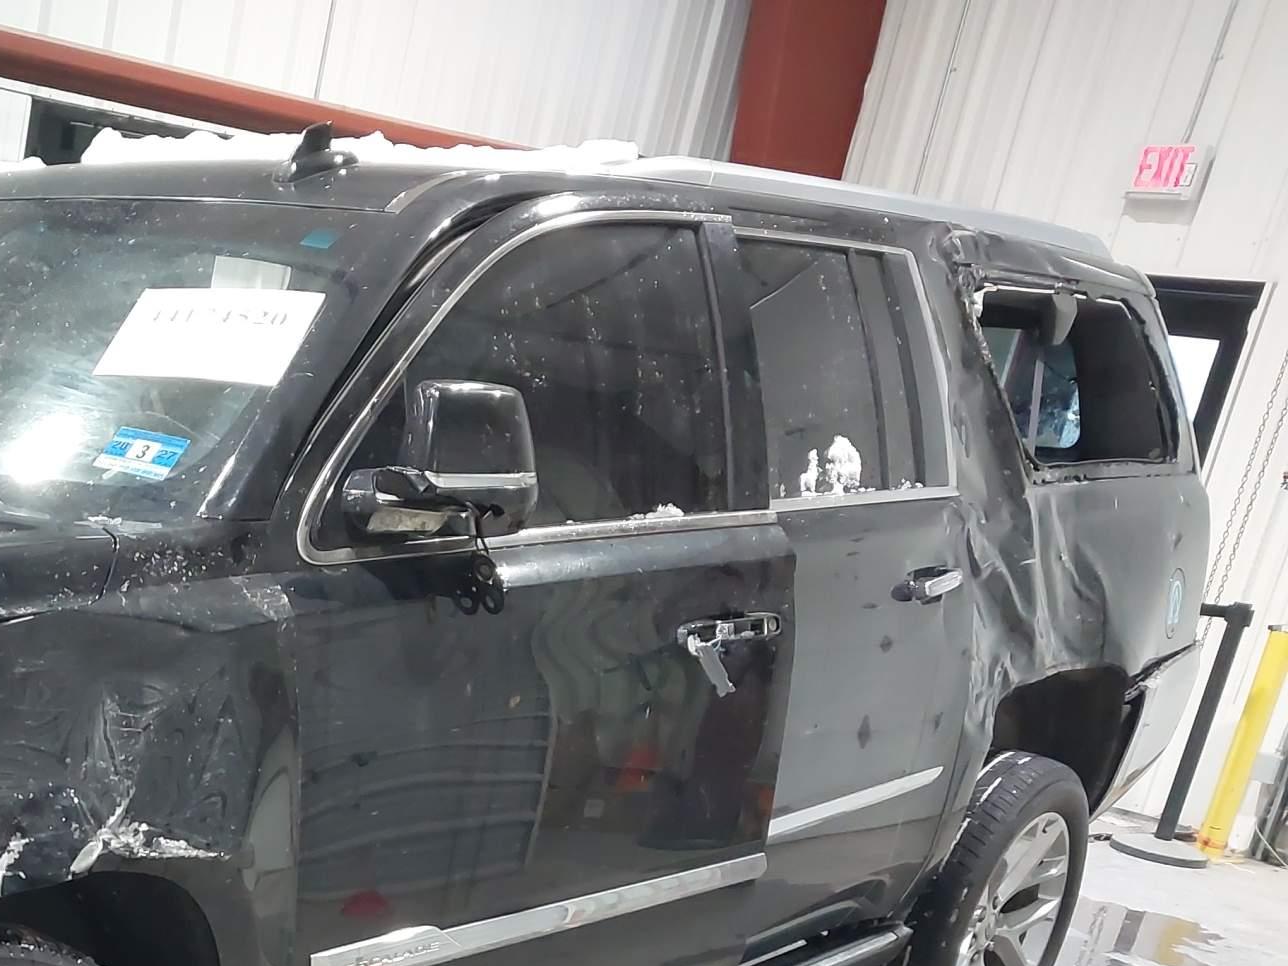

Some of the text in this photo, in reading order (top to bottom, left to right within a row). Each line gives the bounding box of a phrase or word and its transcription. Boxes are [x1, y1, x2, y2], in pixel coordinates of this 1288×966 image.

[1134, 146, 1195, 187] EXIT
[135, 444, 151, 459] 3
[157, 449, 178, 460] 27
